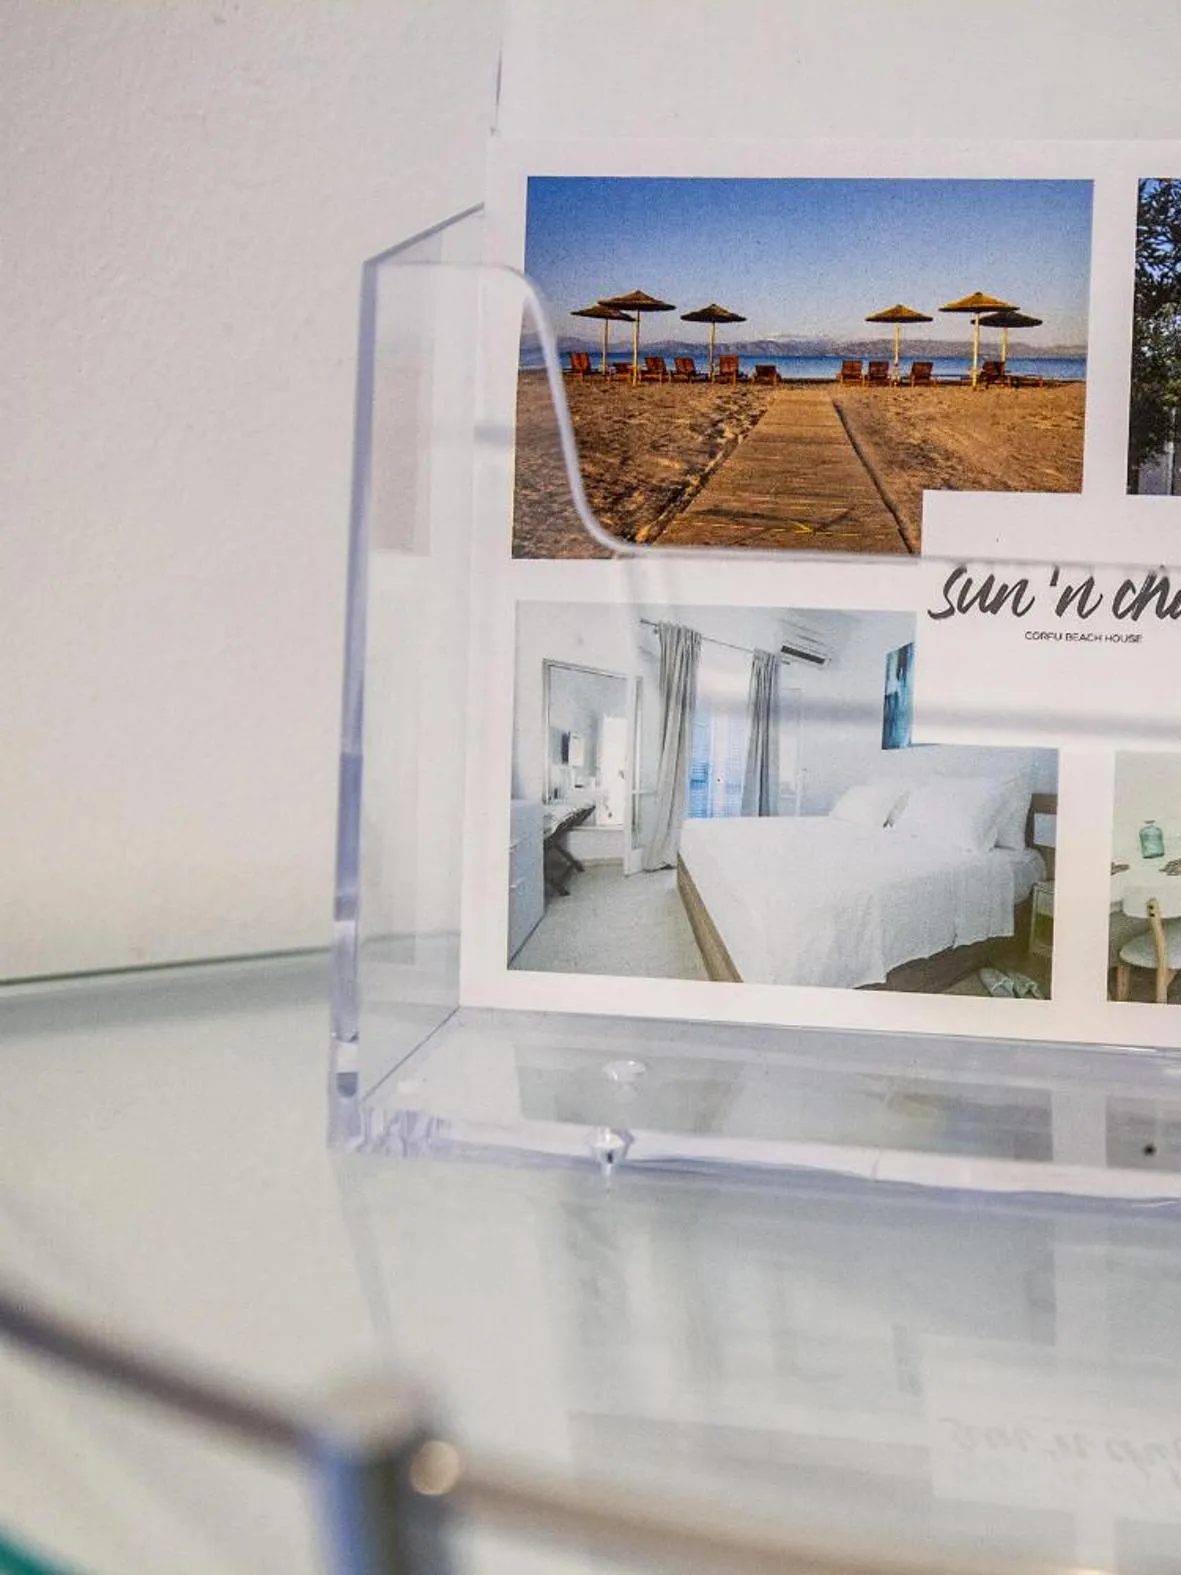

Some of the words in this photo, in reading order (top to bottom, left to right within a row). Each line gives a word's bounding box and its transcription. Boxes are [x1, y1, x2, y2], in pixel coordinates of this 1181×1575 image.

[928, 564, 1035, 620] sun
[1024, 631, 1062, 641] CORFU
[1065, 632, 1101, 642] BEACH
[1105, 633, 1142, 643] HOUSE
